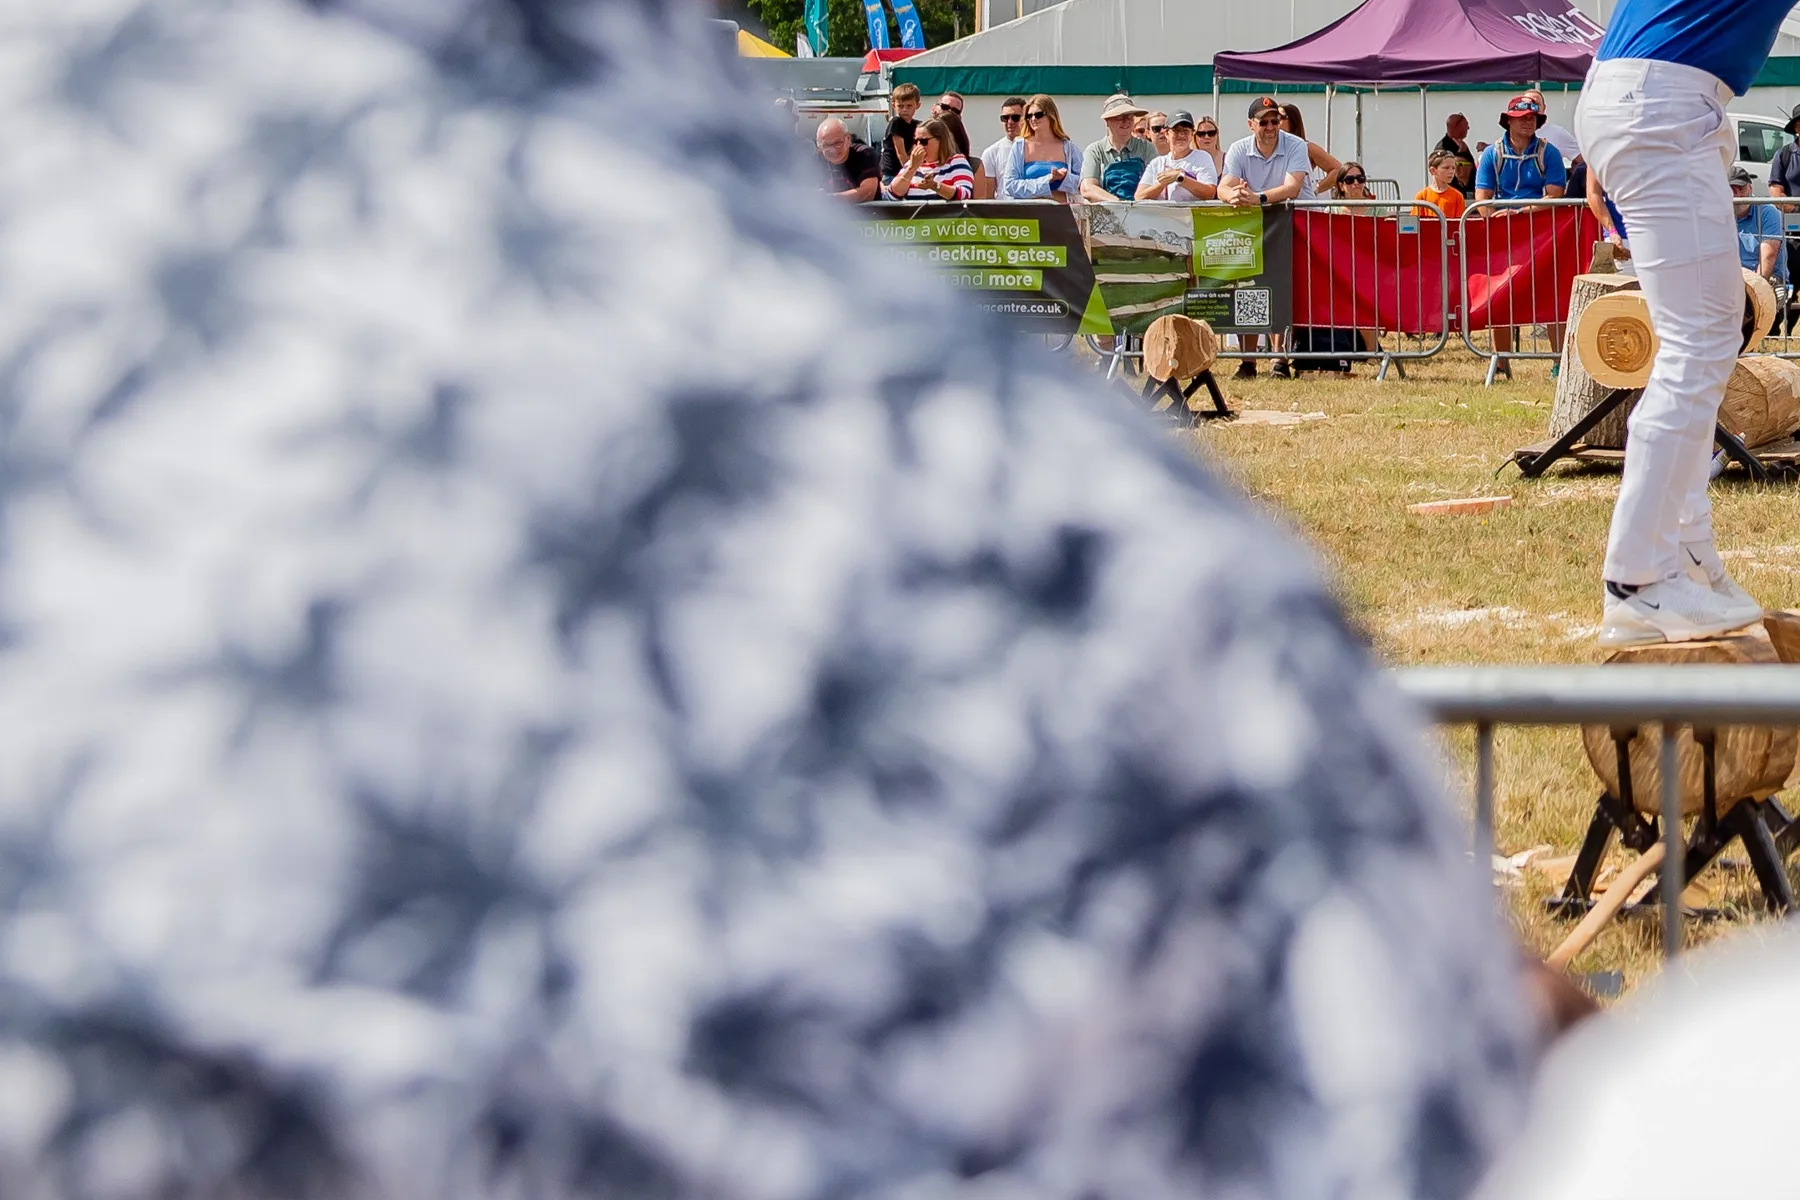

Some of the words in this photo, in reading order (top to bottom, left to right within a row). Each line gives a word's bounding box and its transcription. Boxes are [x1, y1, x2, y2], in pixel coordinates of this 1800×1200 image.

[921, 225, 931, 237] a
[936, 221, 978, 236] wide
[982, 222, 1030, 240] range
[1206, 238, 1252, 247] FENCING
[1207, 246, 1250, 255] CENTRE
[929, 246, 1003, 264] decking,
[1007, 248, 1060, 265] gates,
[952, 271, 984, 286] and
[989, 273, 1033, 287] more
